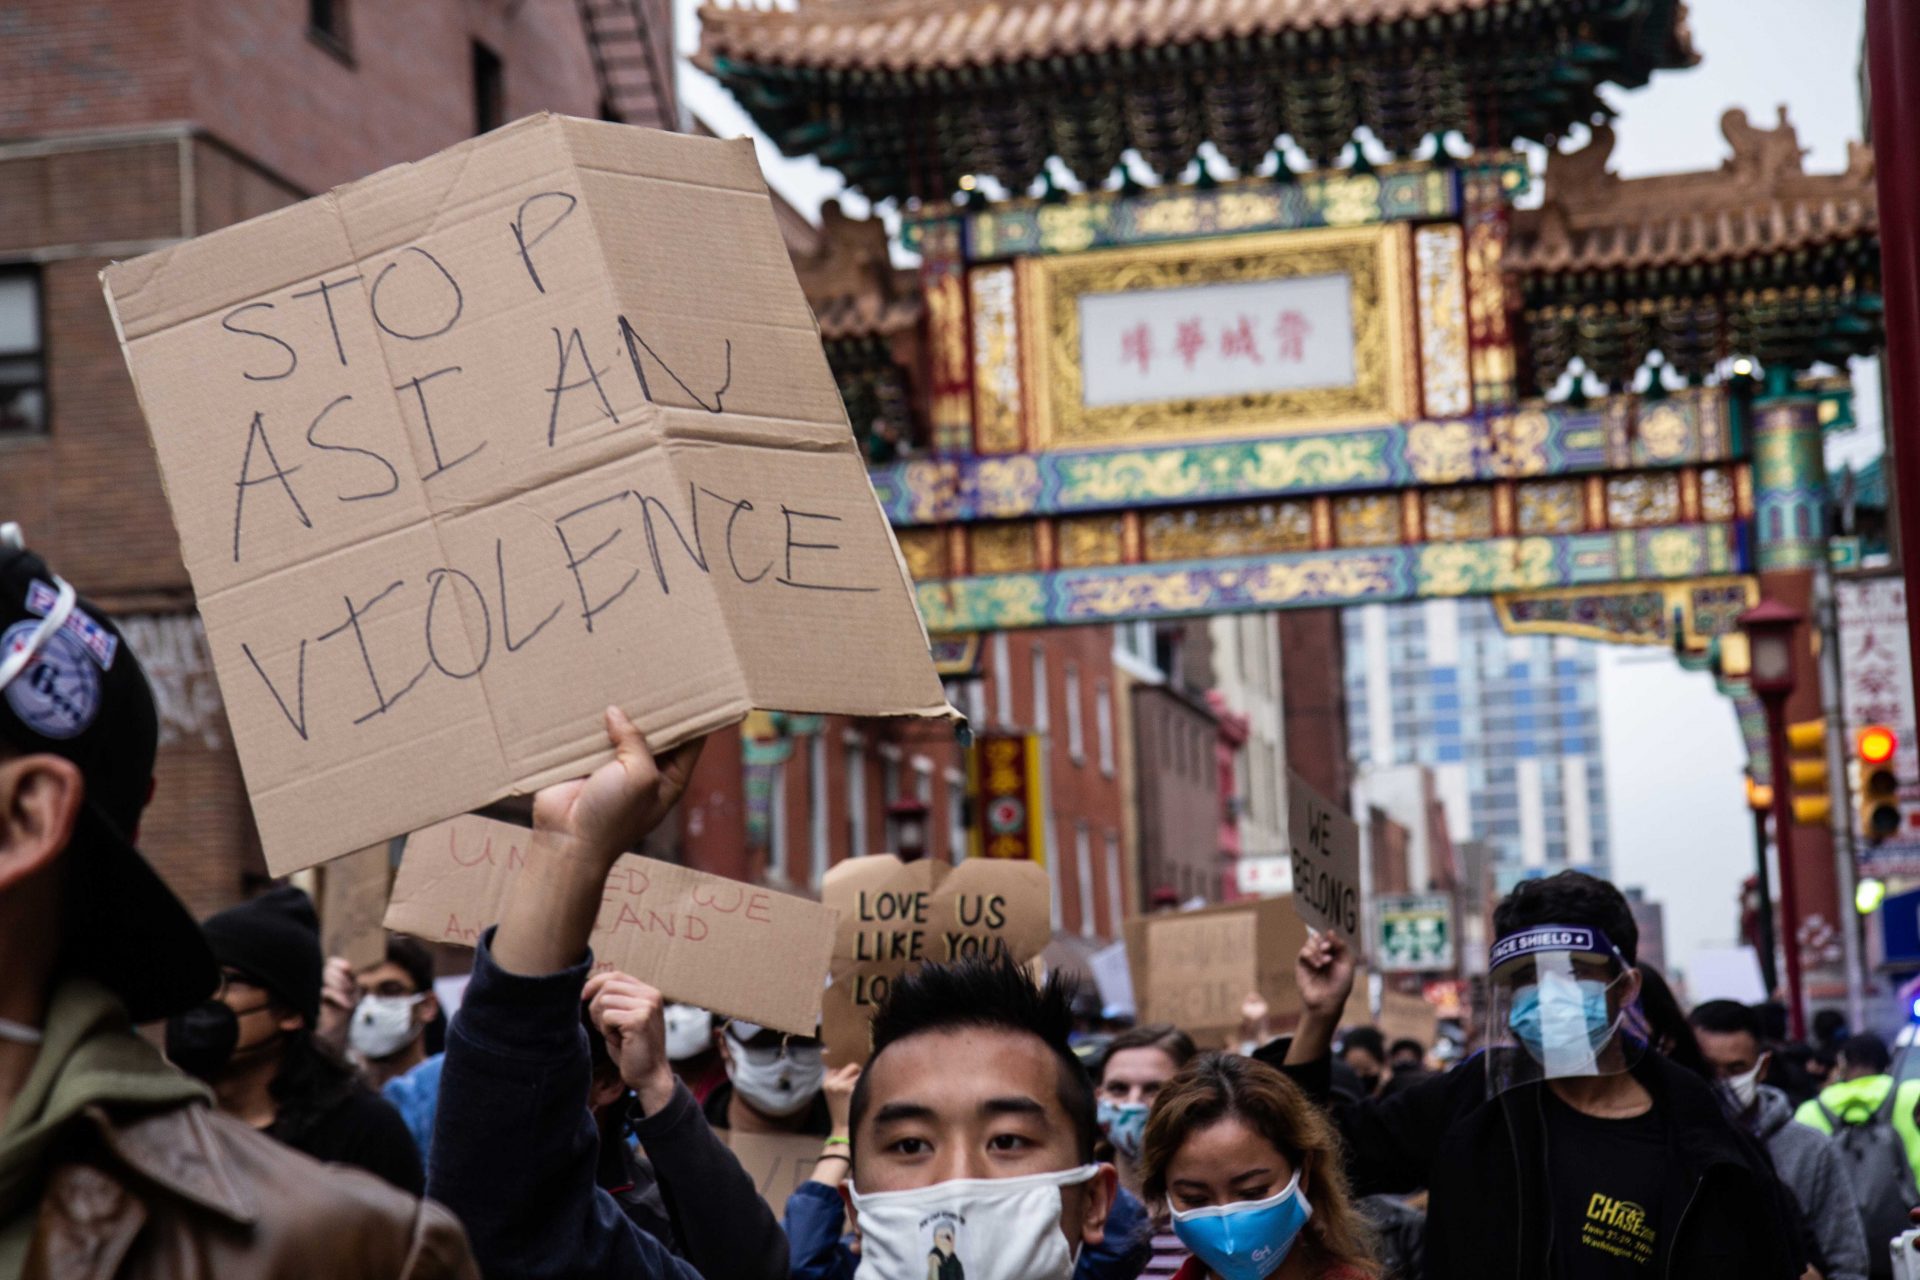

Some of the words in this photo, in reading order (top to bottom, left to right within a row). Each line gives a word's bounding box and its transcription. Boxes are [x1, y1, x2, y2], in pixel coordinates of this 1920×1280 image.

[223, 192, 577, 381] STOP
[234, 315, 731, 563] ASIAN
[241, 481, 881, 740] VIOLENCE
[1307, 802, 1331, 857] WE
[451, 827, 650, 895] UNED
[692, 884, 771, 924] WE
[1293, 847, 1356, 935] BELONG
[597, 898, 709, 942] AND
[857, 891, 929, 923] LOVE
[957, 895, 1007, 929] US
[854, 931, 925, 961] LIKE
[943, 932, 1006, 964] YOU
[1518, 931, 1573, 950] SHIELD
[1586, 1192, 1645, 1236] CHASE
